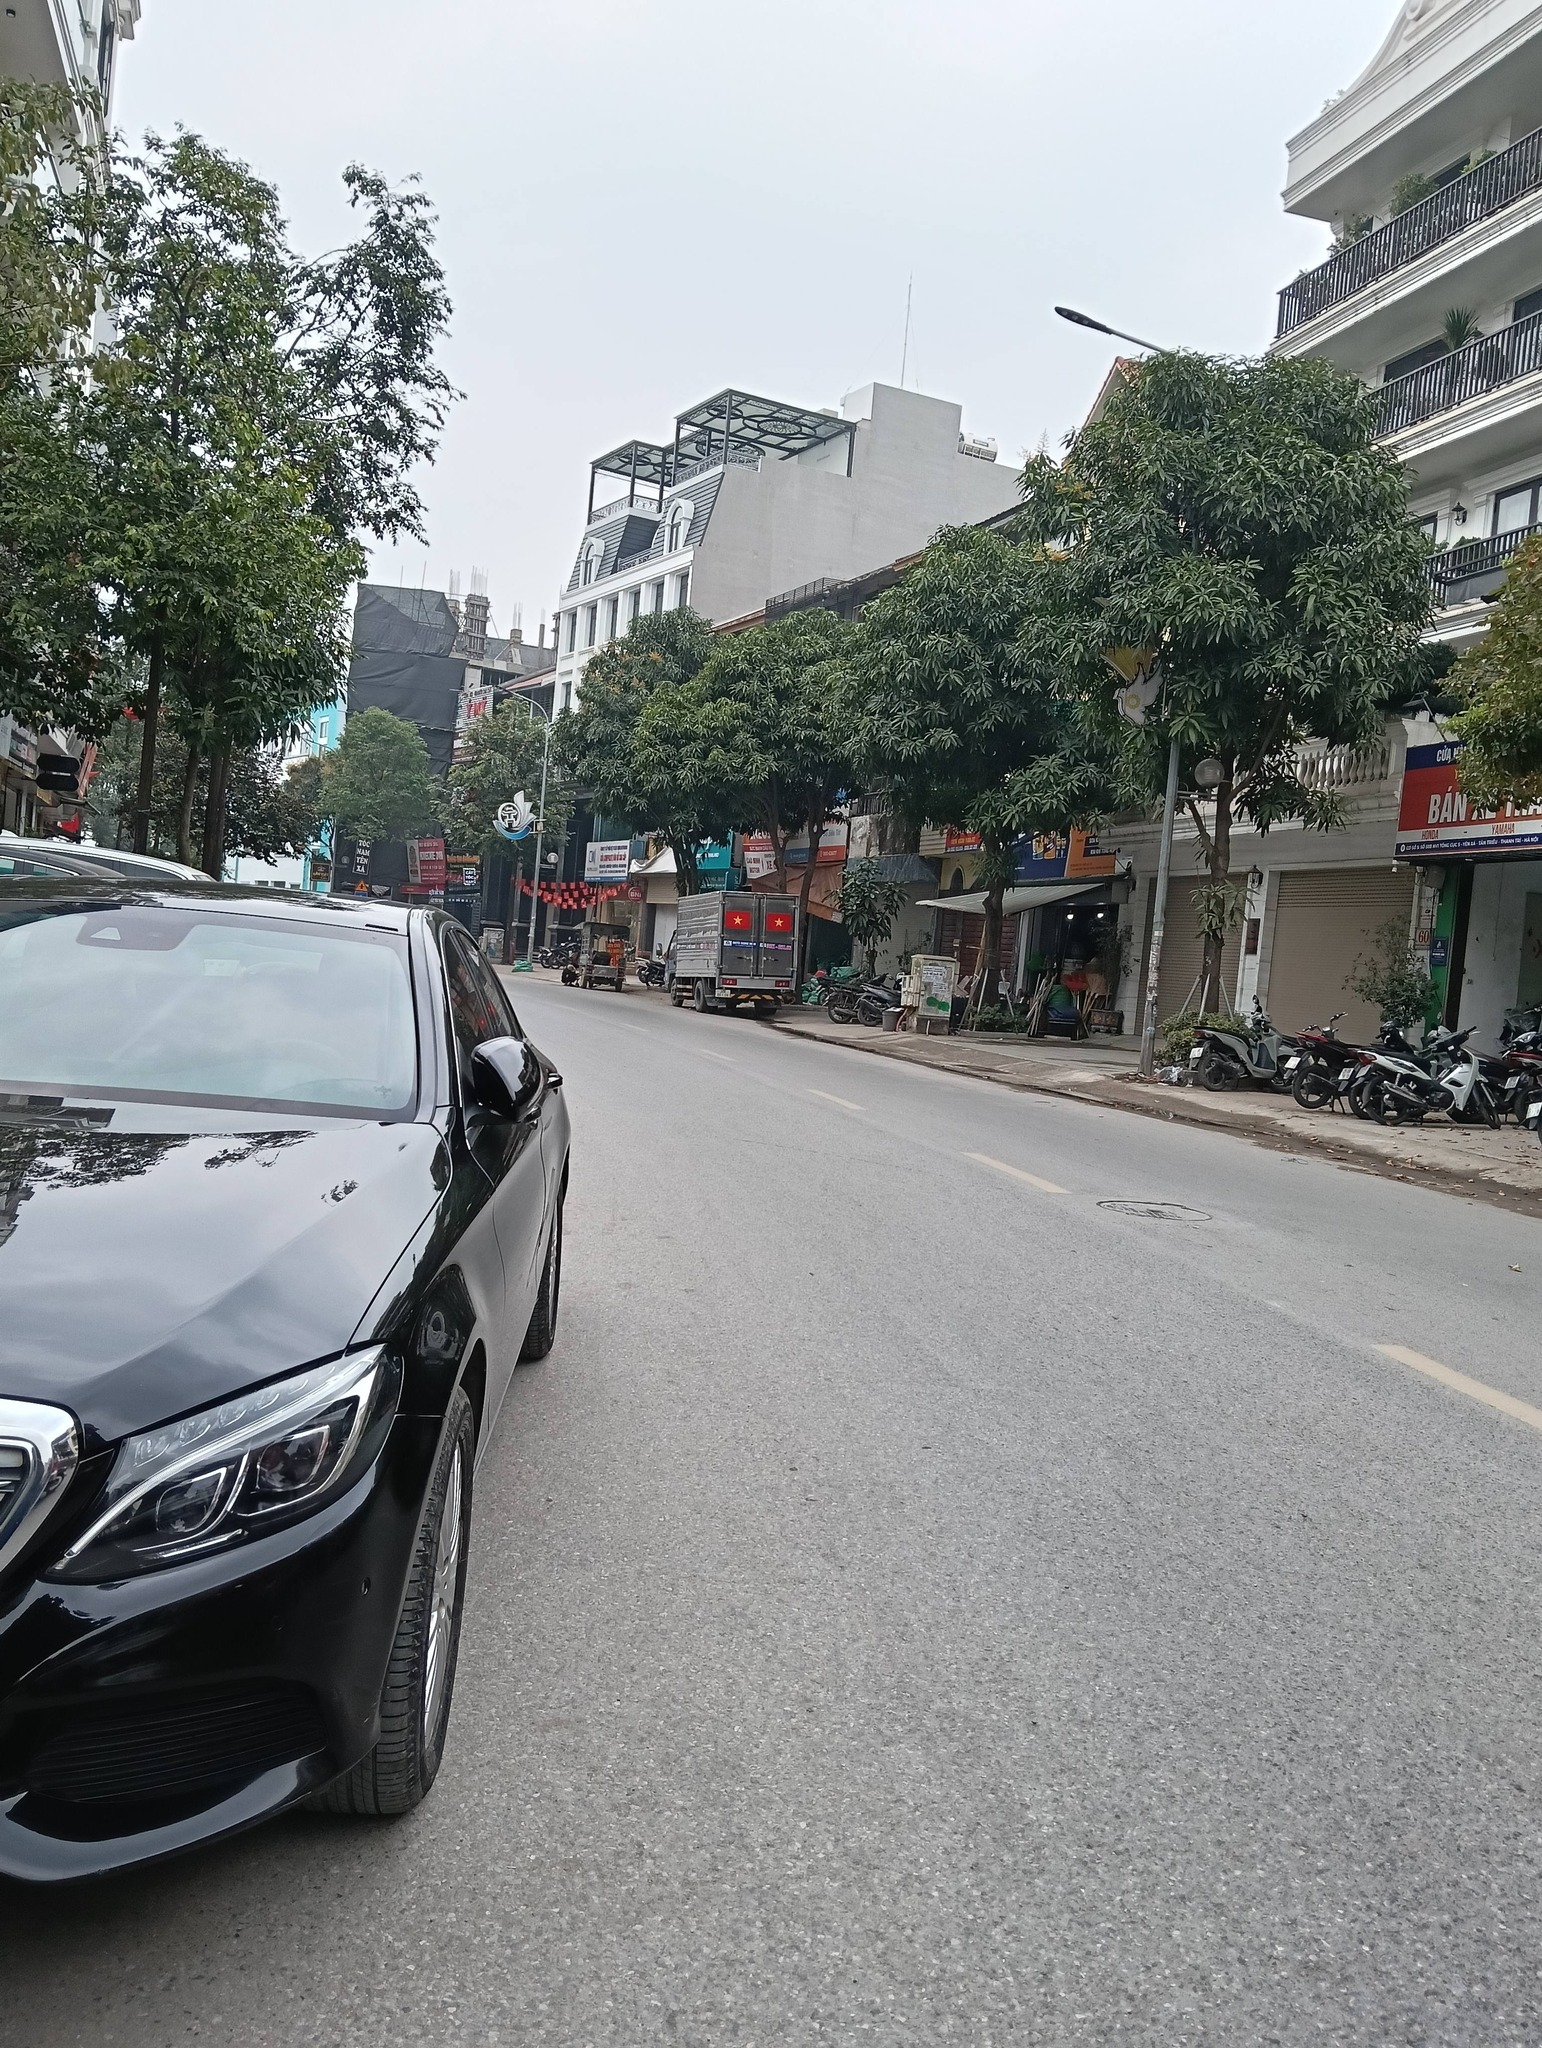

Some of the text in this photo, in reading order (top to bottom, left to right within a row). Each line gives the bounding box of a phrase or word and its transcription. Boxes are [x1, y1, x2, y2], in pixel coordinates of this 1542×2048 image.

[1436, 745, 1451, 762] CỬA
[1428, 785, 1467, 824] BÁN
[1421, 823, 1515, 840] HONDA YAMAHA
[356, 848, 370, 857] NAM
[356, 856, 368, 865] YÊN
[1418, 930, 1430, 943] 60
